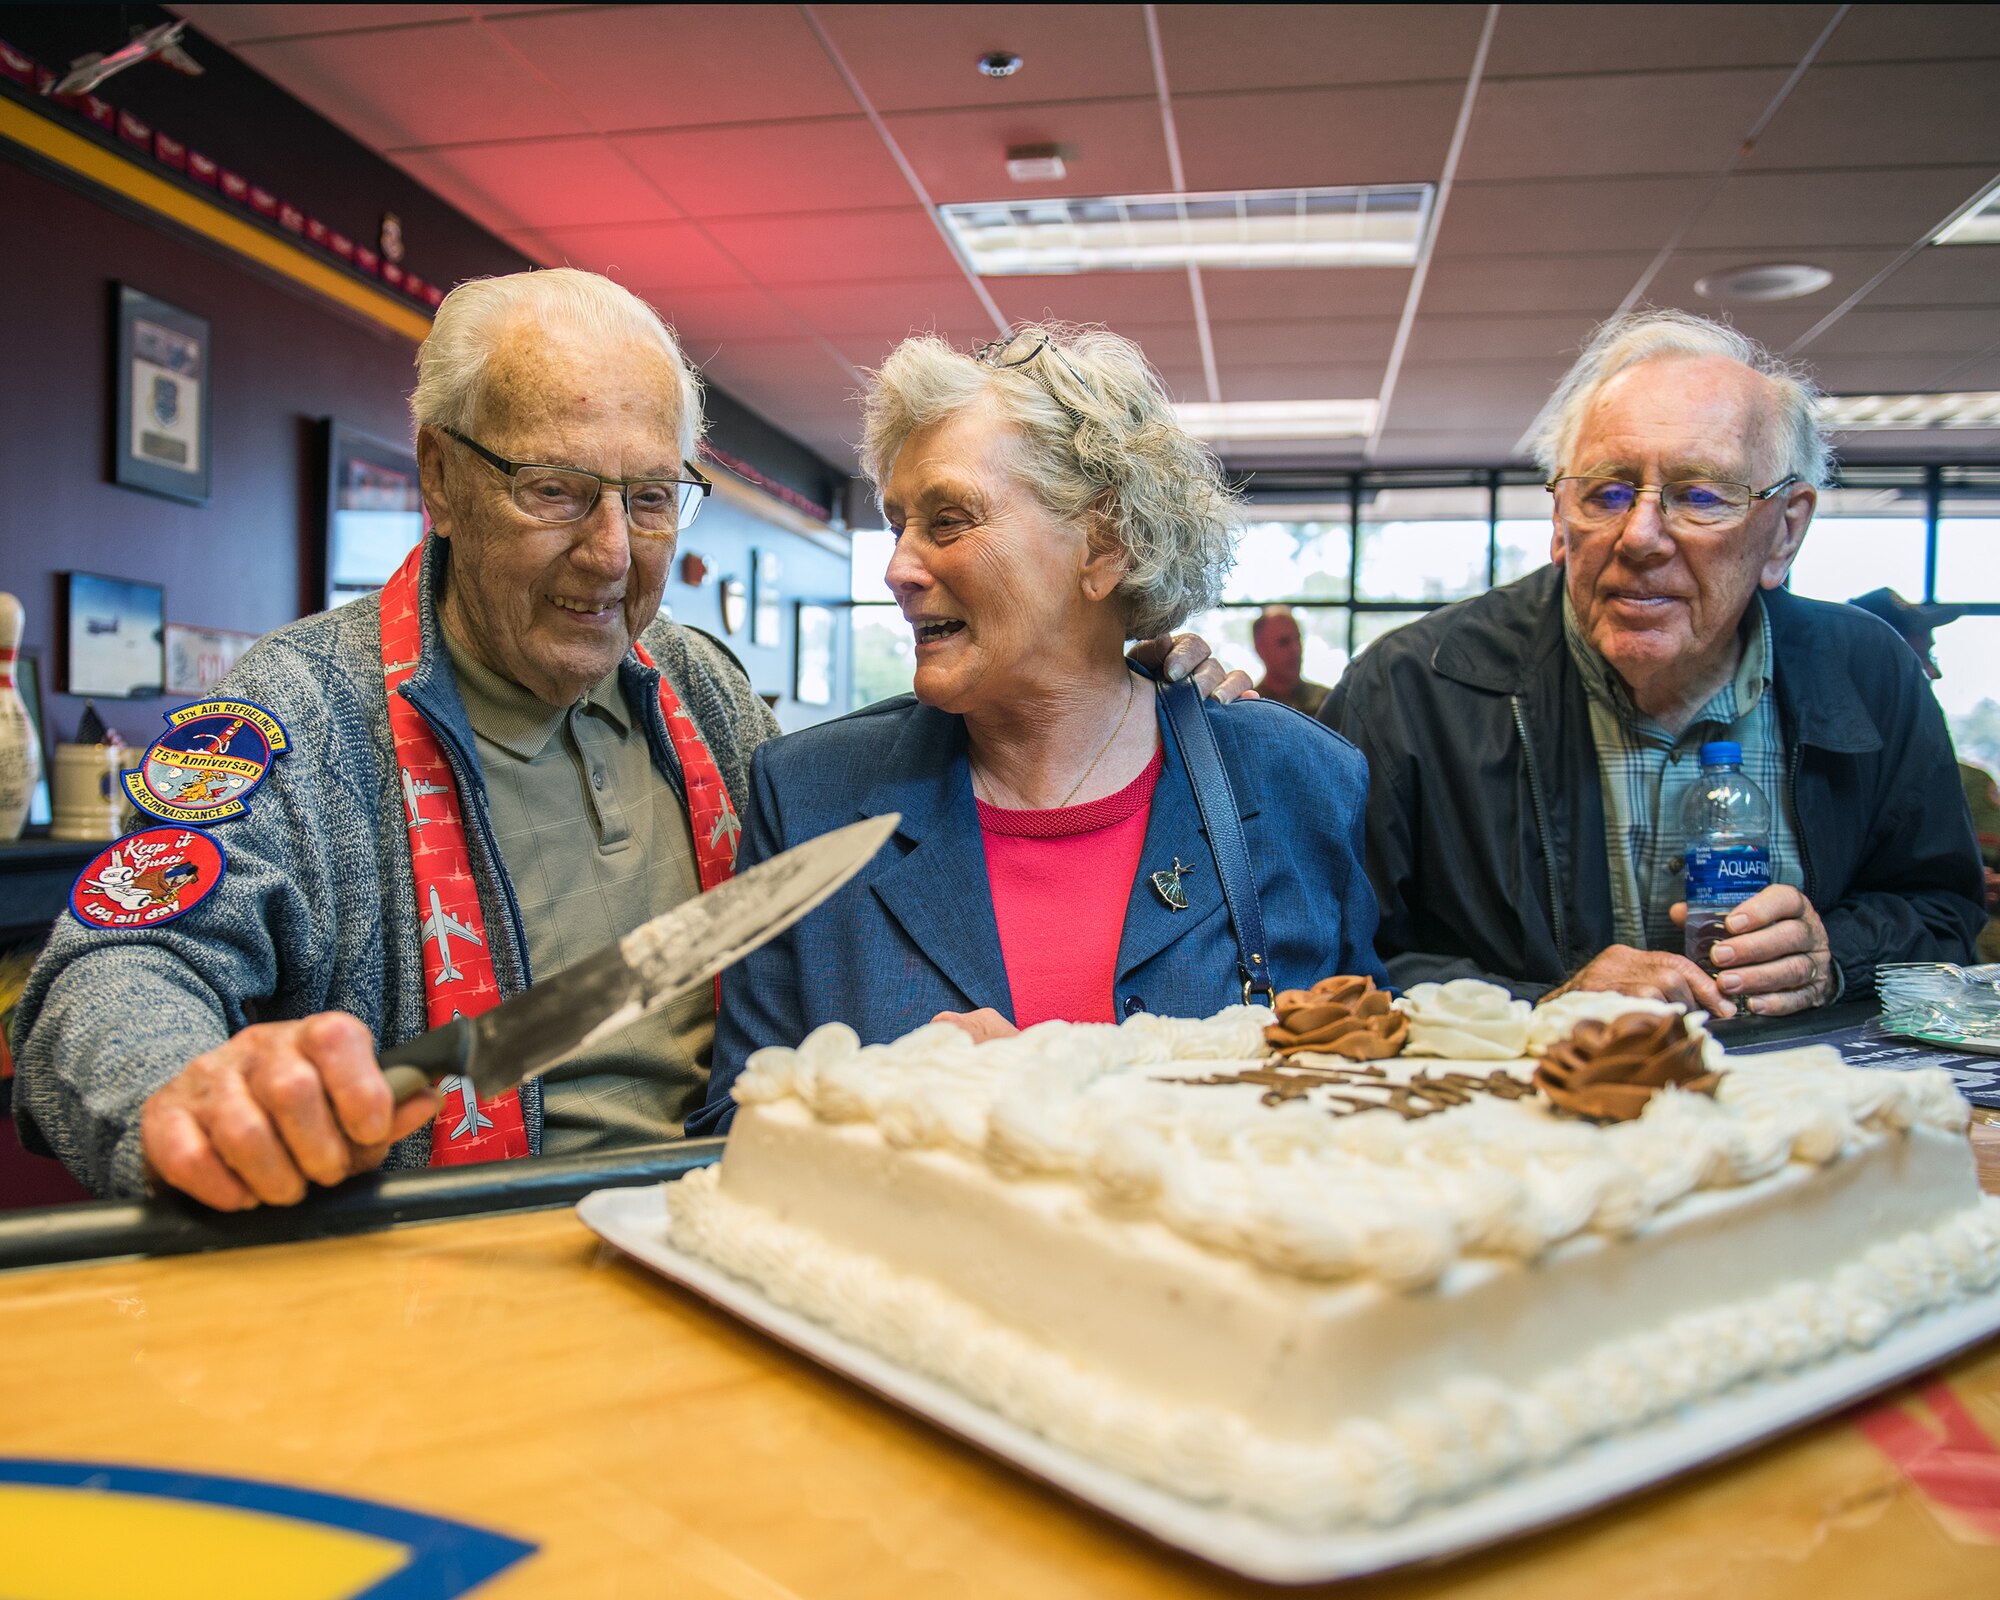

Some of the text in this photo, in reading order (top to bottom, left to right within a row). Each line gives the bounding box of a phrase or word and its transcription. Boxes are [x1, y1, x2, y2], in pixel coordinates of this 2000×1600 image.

[177, 703, 283, 745] 9TH AIR REFUELING SQ
[153, 748, 261, 777] 75th Anniversary
[128, 773, 241, 820] 9TH RECONNAISSANCE SQ
[123, 831, 196, 859] Keep it
[133, 851, 185, 878] Gucci
[1717, 859, 1770, 879] AQUAFIN
[83, 900, 180, 924] LPA all day
